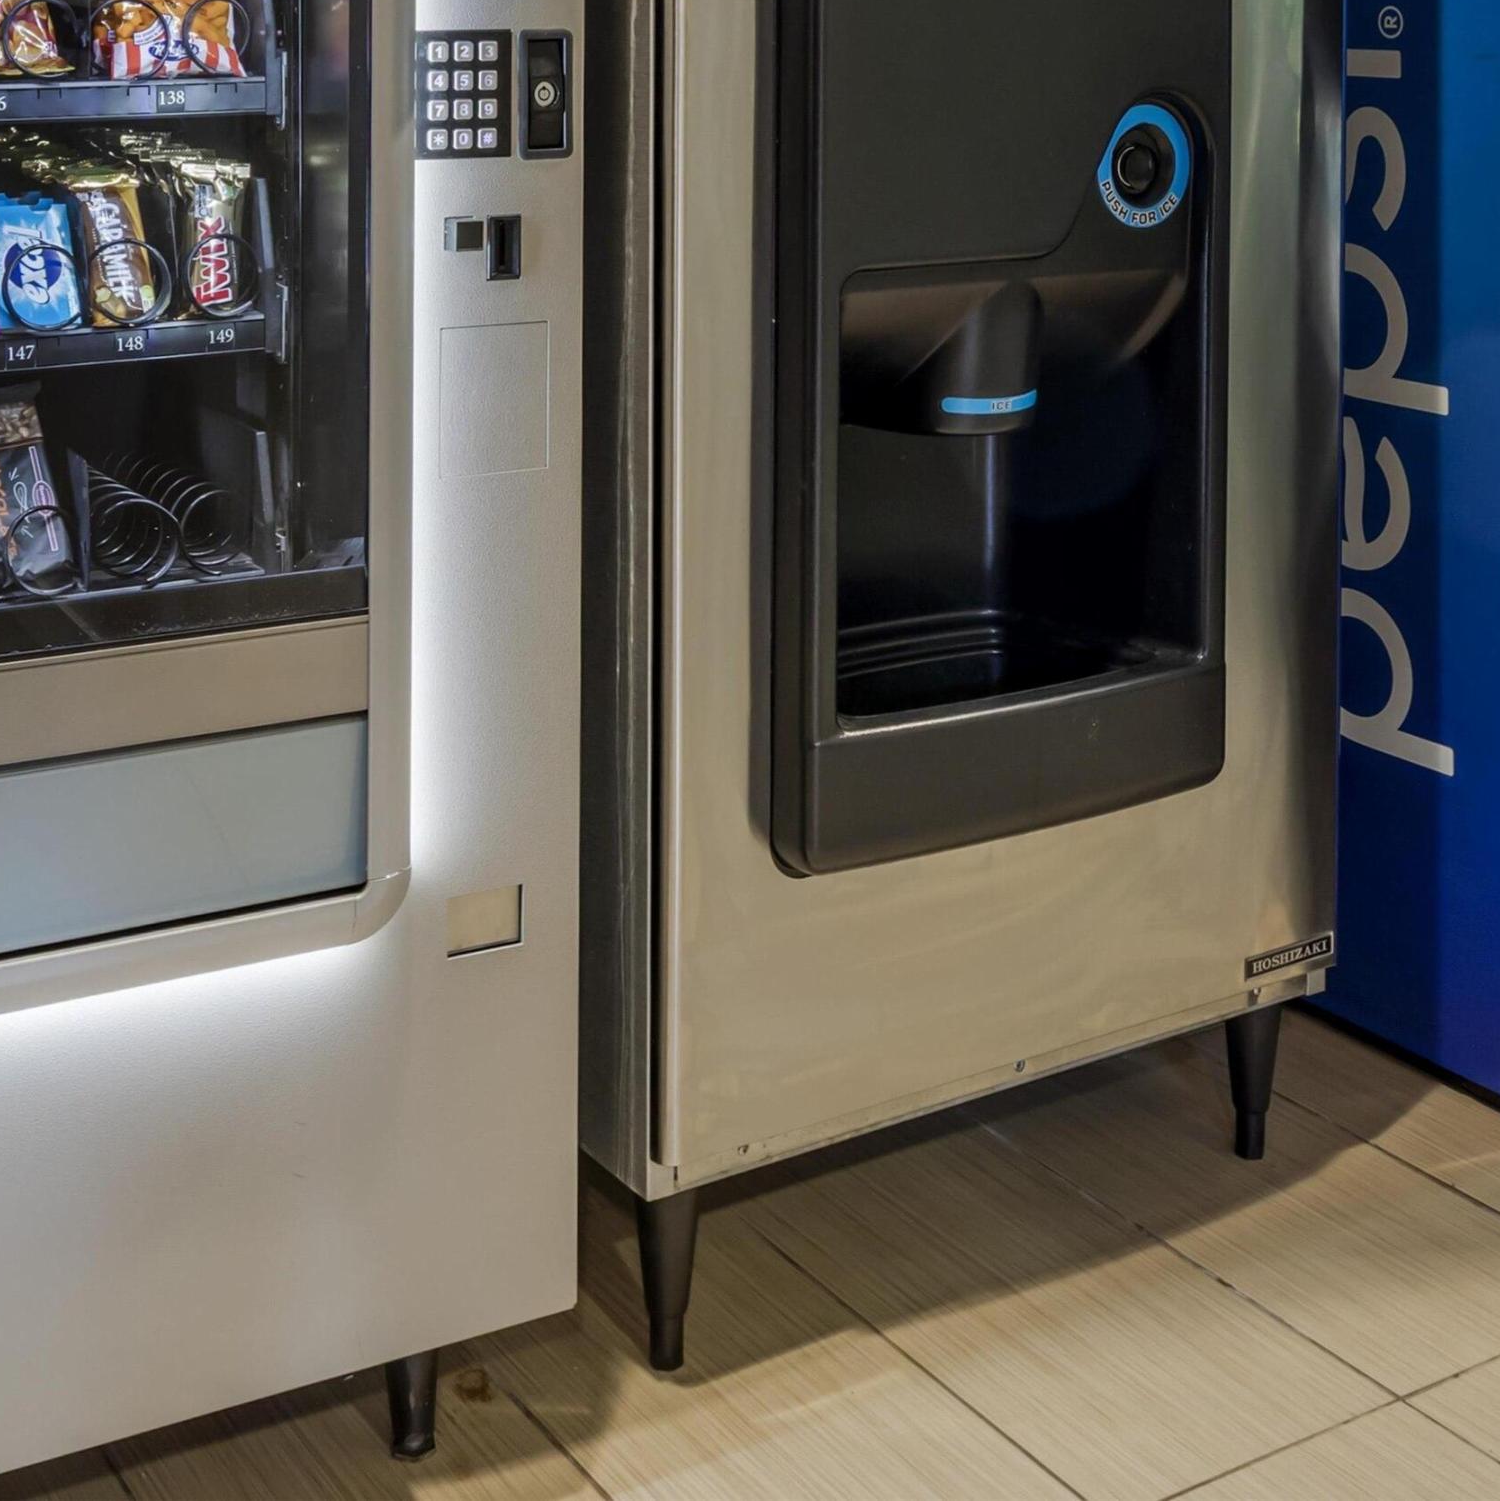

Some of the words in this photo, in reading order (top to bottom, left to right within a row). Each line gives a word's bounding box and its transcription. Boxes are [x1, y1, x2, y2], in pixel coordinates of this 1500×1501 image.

[434, 46, 443, 59] 1
[459, 46, 469, 58] 2
[484, 45, 494, 58] 3
[433, 74, 444, 87] 4
[459, 74, 469, 87] 5
[484, 74, 493, 86] 6
[158, 90, 186, 106] 138
[434, 104, 444, 117] 7
[459, 104, 469, 117] 8
[484, 103, 494, 116] 9
[459, 133, 469, 146] 0
[1102, 181, 1129, 220] PUSH
[1131, 212, 1157, 225] FOR
[1159, 194, 1178, 217] ICE
[194, 215, 233, 307] TWIX
[208, 328, 235, 344] 149
[116, 336, 144, 352] 148
[7, 344, 36, 362] 147
[1252, 939, 1329, 974] HOSHIZAKI
